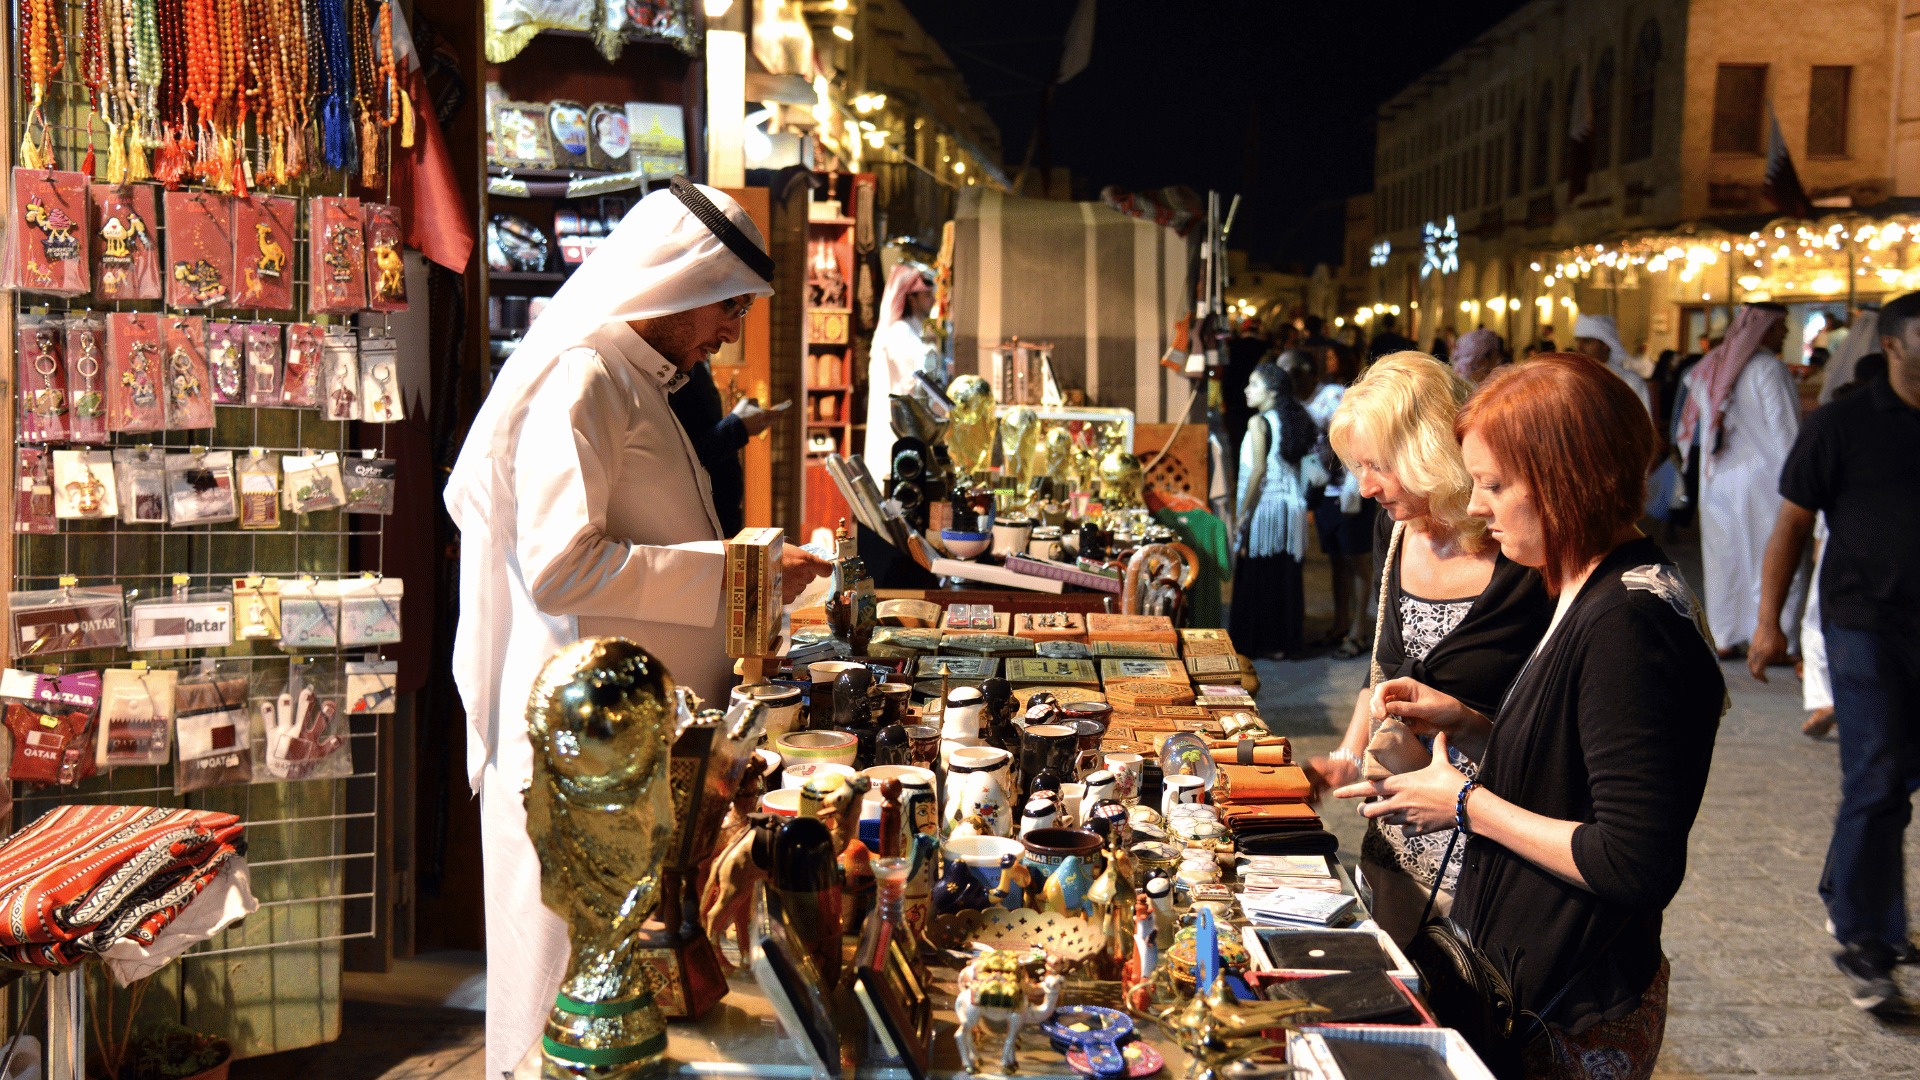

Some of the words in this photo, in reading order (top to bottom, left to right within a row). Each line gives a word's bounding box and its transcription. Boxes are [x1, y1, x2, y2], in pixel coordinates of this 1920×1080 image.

[60, 624, 65, 635] I
[81, 618, 116, 632] QATAR
[186, 617, 226, 634] Qatar
[24, 748, 57, 760] QATAR
[1025, 849, 1047, 864] QATAR
